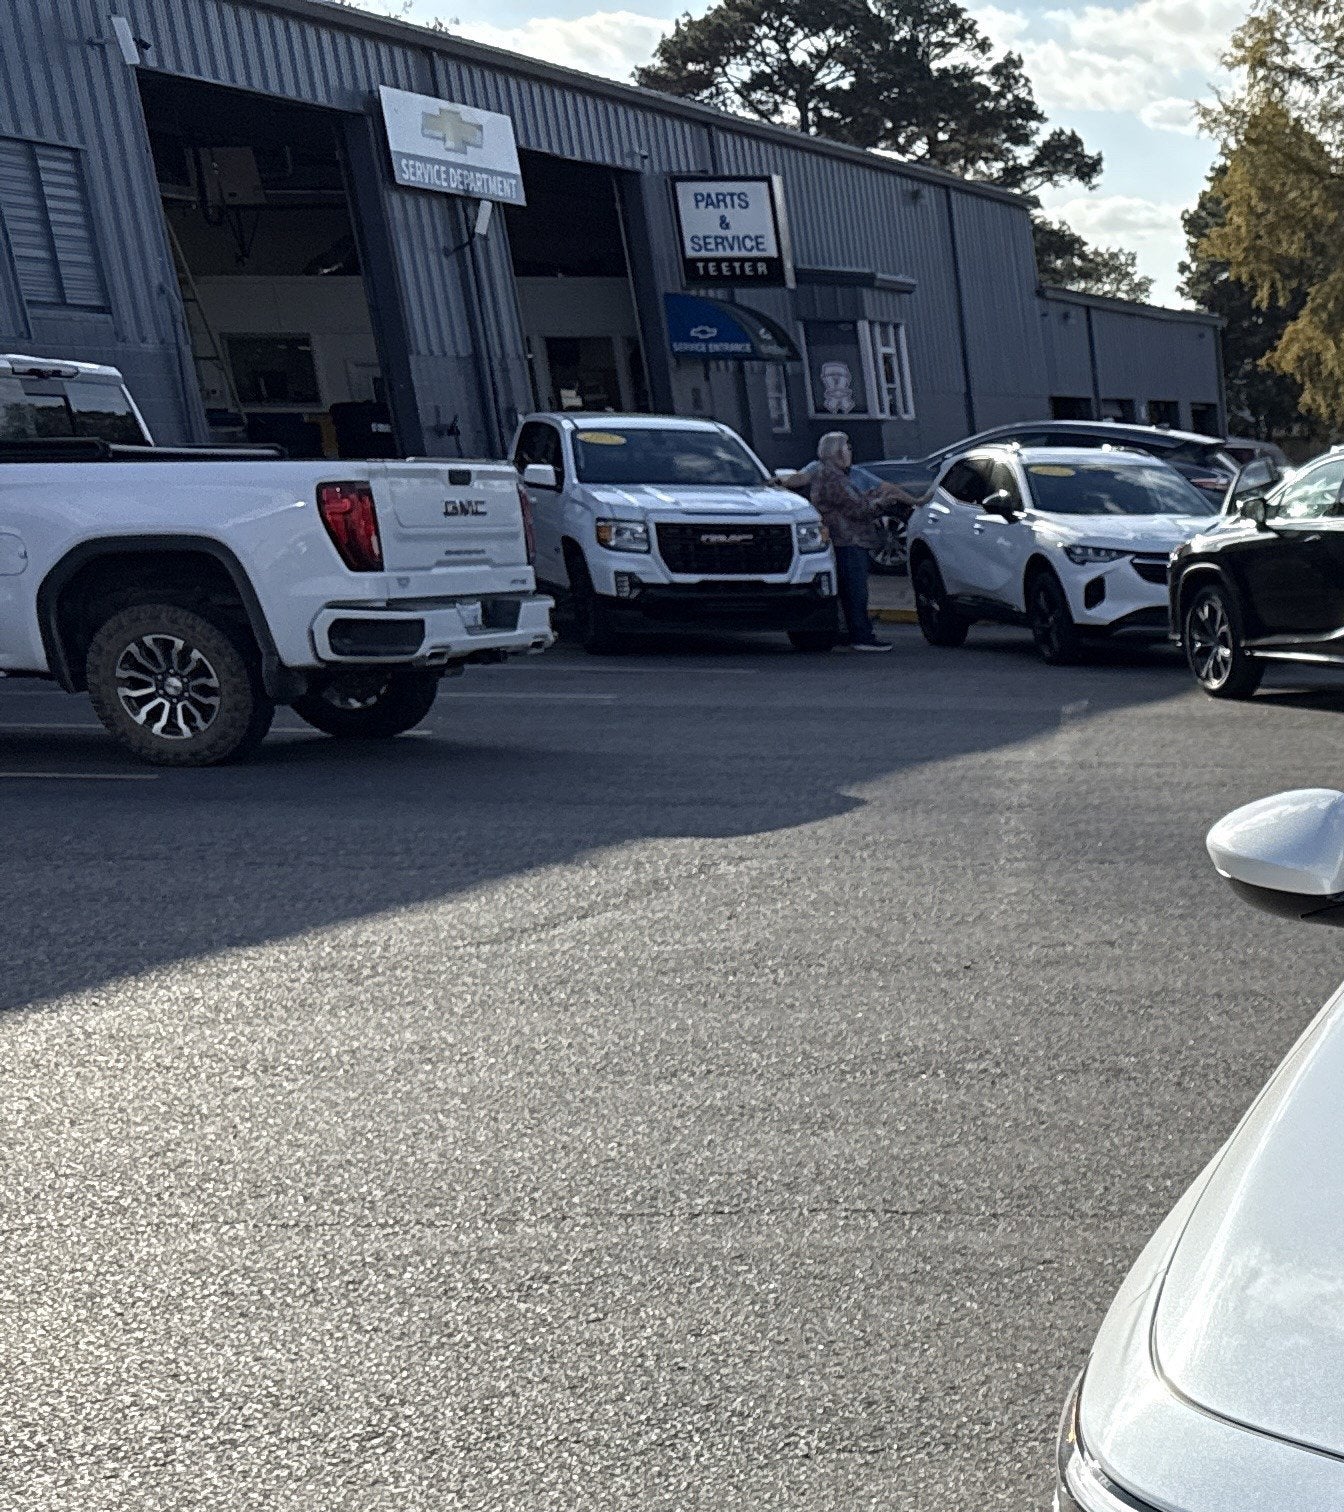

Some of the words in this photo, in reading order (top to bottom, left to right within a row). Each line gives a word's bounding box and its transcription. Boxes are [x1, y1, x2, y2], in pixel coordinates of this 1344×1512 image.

[401, 158, 448, 187] SERVICE
[450, 167, 517, 199] DEPARTMENT
[693, 192, 750, 209] PARTS
[719, 214, 730, 230] &
[690, 234, 767, 252] SERVICE
[696, 262, 768, 276] TEETER
[443, 500, 487, 516] GMC
